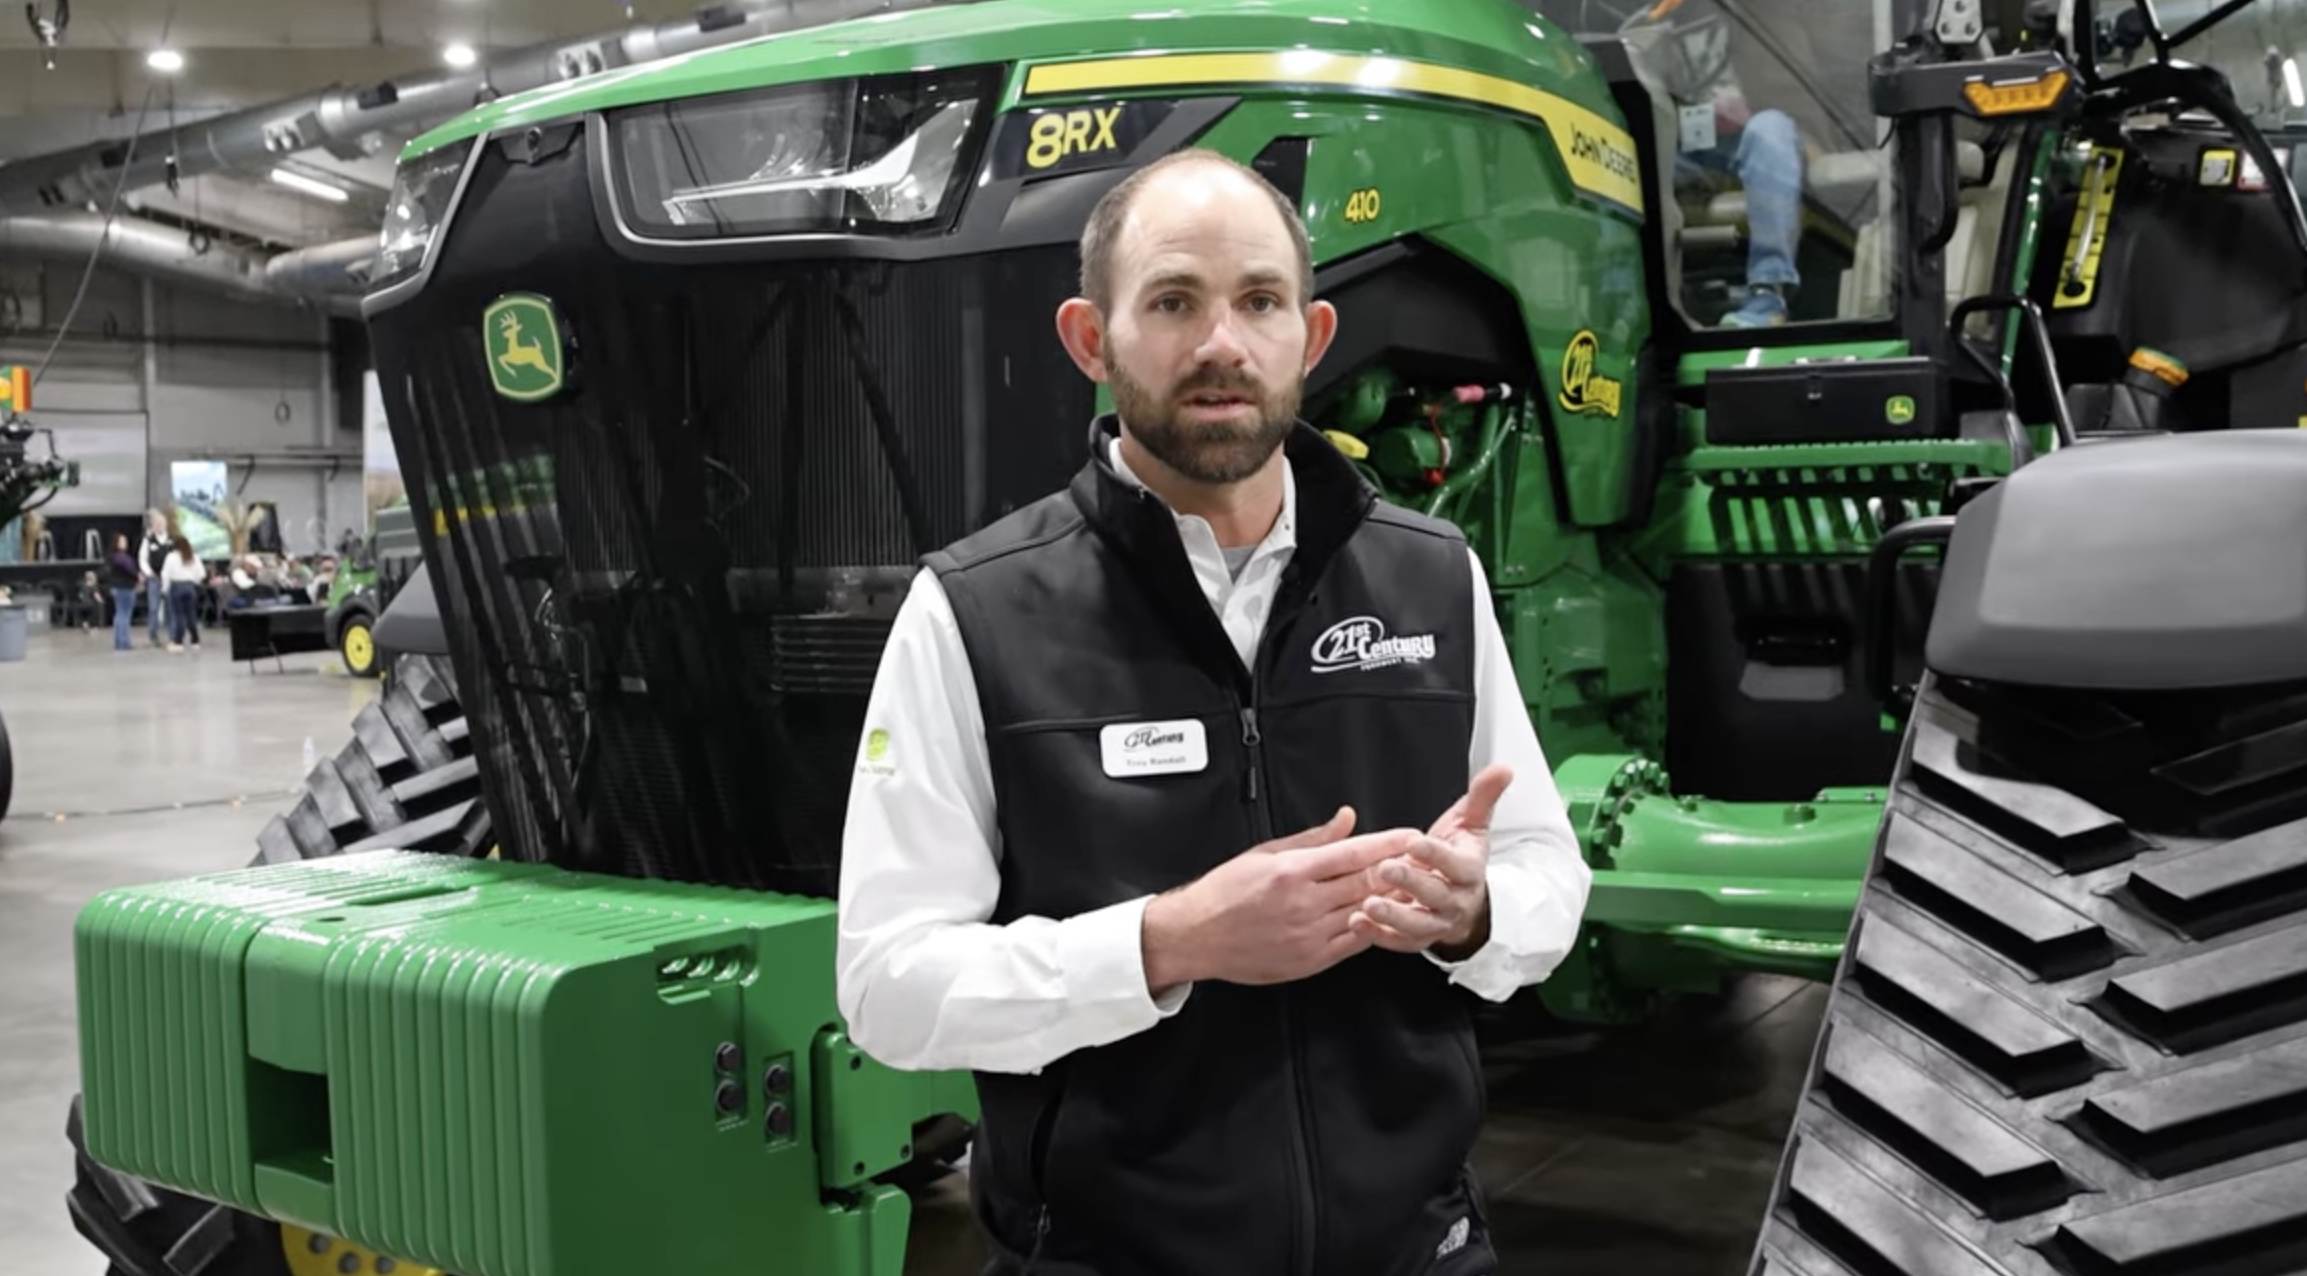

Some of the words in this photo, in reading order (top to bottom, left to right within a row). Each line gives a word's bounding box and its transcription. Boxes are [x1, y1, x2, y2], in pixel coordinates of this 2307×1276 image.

[1026, 106, 1121, 168] 8RX
[1570, 121, 1601, 167] JOHN
[1345, 188, 1380, 221] 410
[1328, 621, 1371, 661] 21st
[1357, 634, 1436, 661] Century
